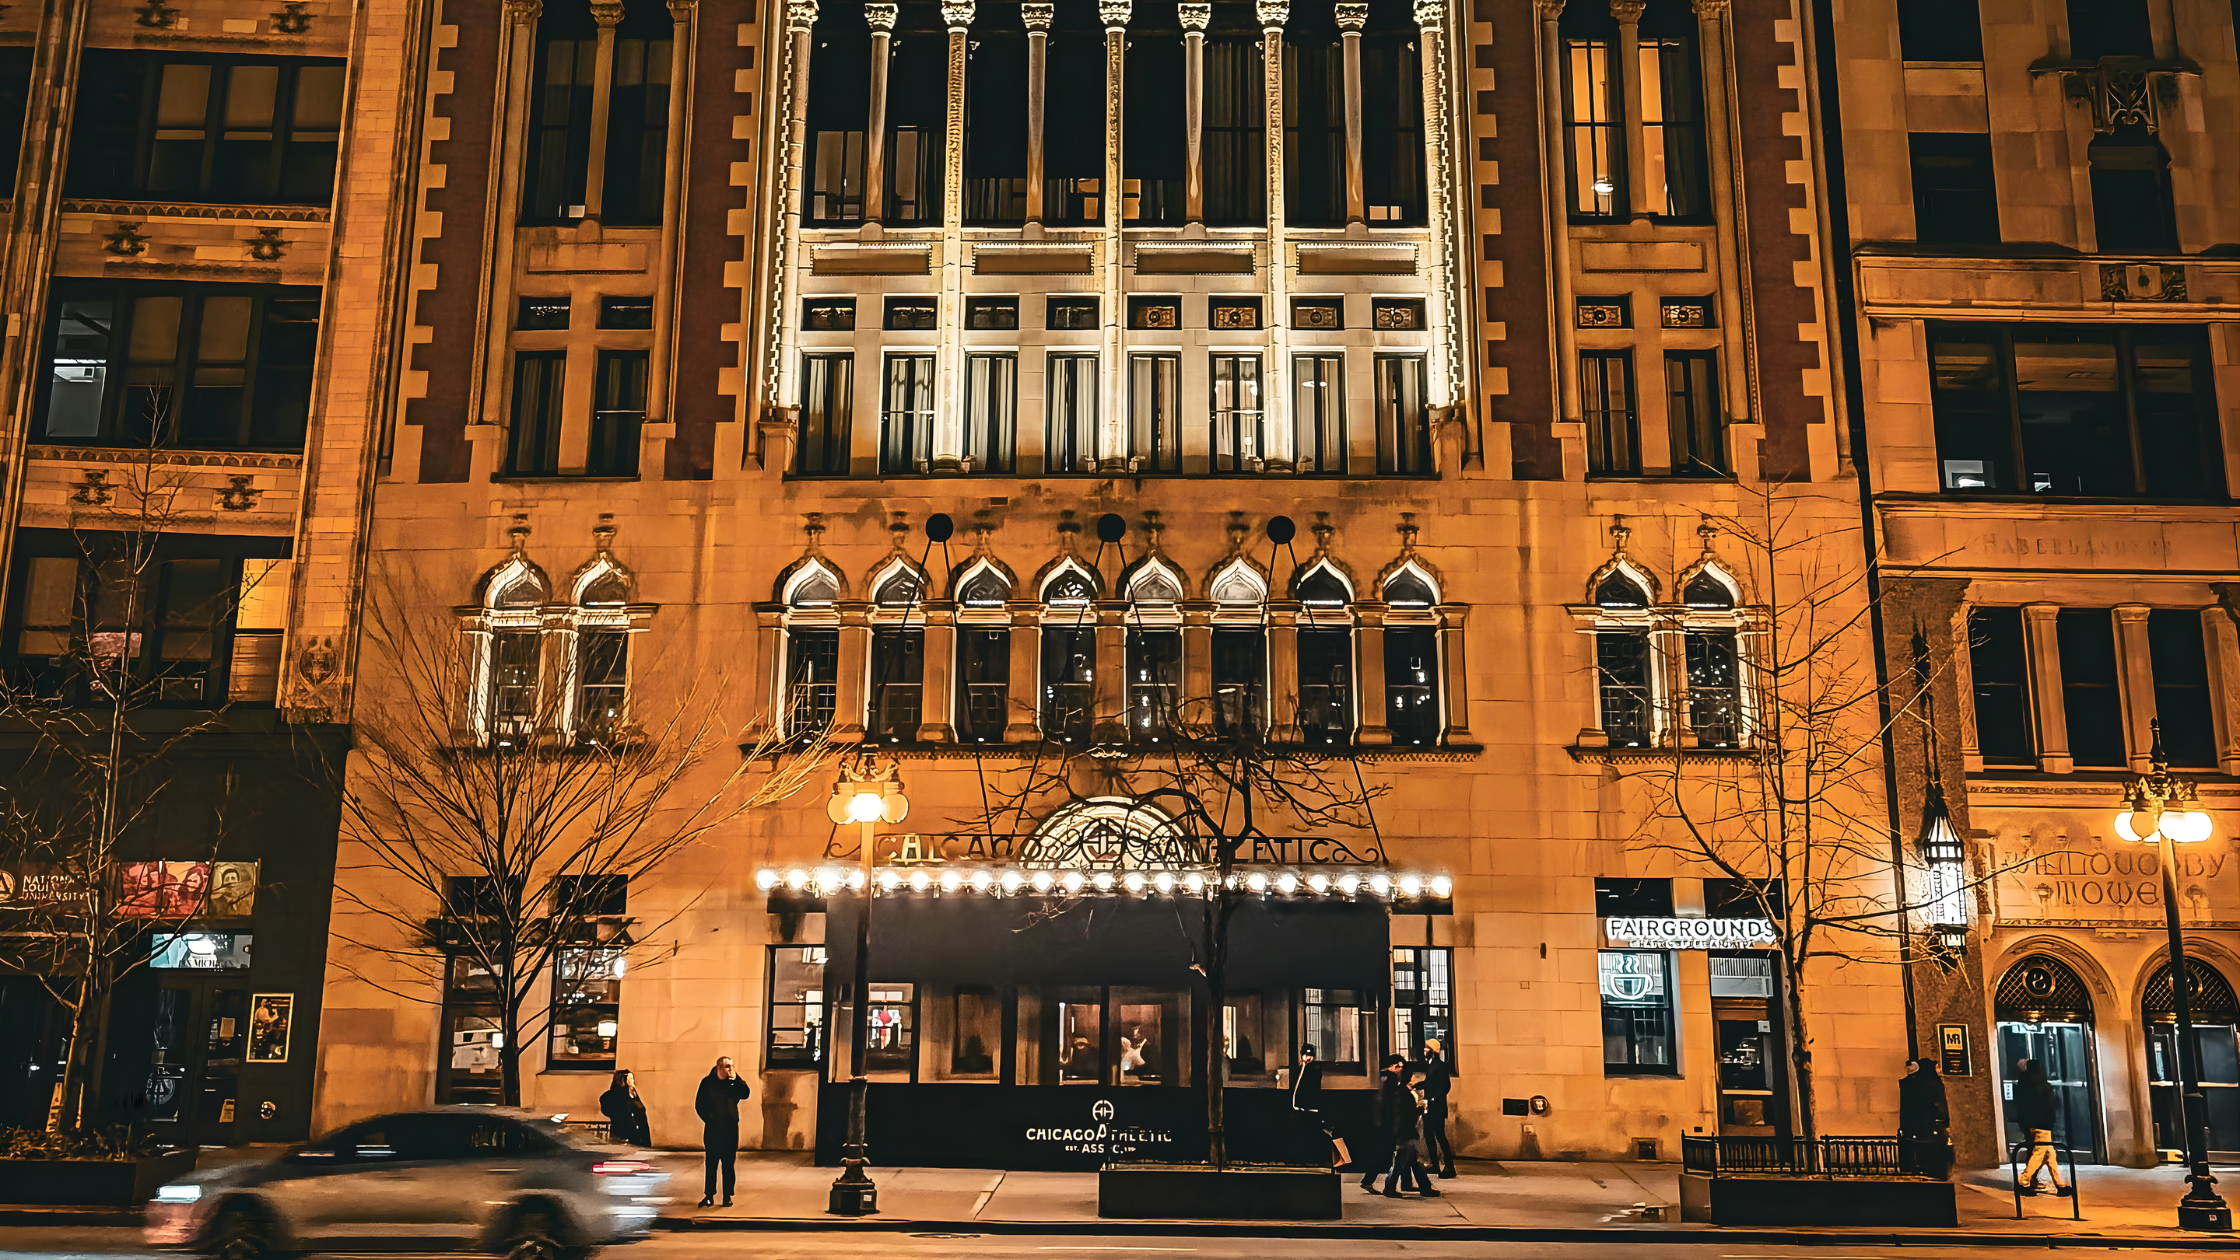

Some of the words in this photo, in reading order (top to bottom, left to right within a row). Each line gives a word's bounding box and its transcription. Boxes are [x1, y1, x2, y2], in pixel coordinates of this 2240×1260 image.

[1983, 533, 2172, 556] HABERDASH
[2001, 852, 2226, 878] WILLOUGBY
[23, 875, 79, 884] NATION
[2056, 880, 2160, 905] TOWE
[1610, 919, 1775, 938] FAIRGROUNDS
[2032, 972, 2046, 990] 8
[1026, 1127, 1095, 1142] CHICAGO
[1081, 1143, 1124, 1154] ASSC.
